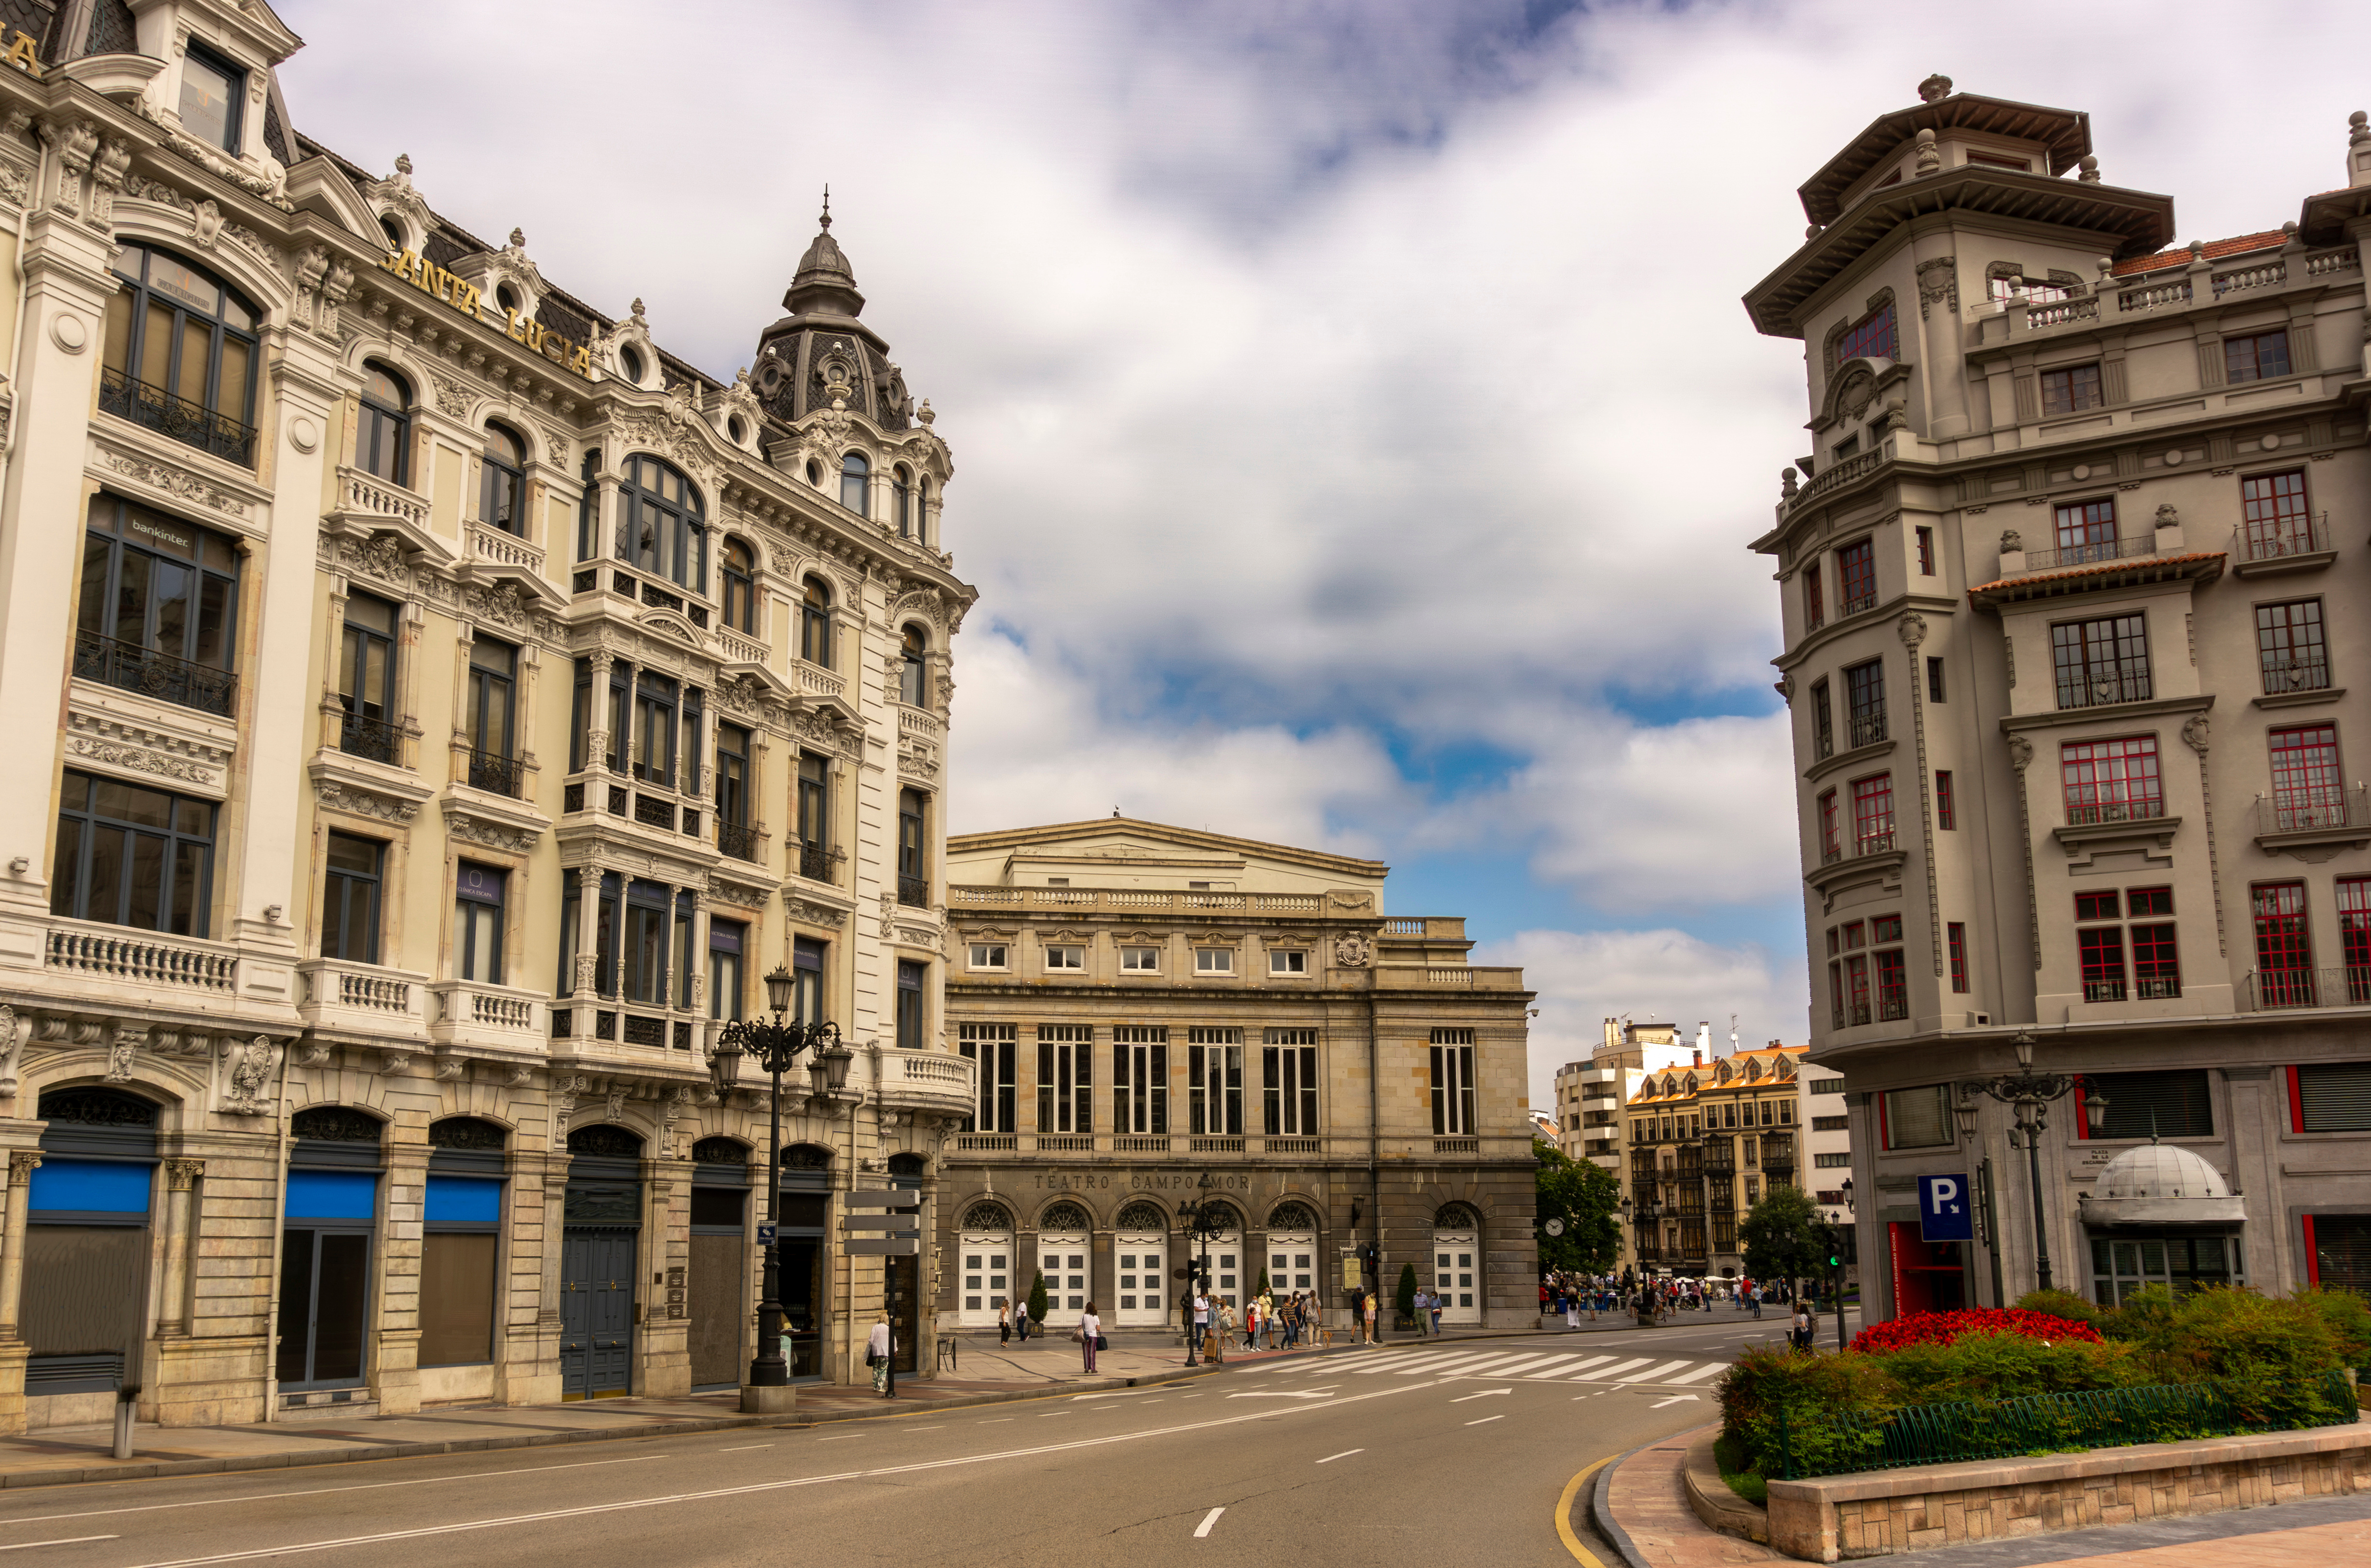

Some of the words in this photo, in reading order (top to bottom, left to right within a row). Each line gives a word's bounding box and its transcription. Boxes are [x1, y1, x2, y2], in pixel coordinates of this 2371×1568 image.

[183, 100, 222, 126] GARRIGUES
[157, 278, 209, 310] GARRIGUES
[505, 306, 593, 379] LUCIA
[362, 389, 398, 410] GARRIGUES
[458, 886, 475, 894] CLÍNICA
[476, 890, 492, 898] ESCAPA
[1035, 1176, 1109, 1189] TEATRO
[1131, 1176, 1248, 1189] CAMPOMOR
[1931, 1178, 1957, 1214] P
